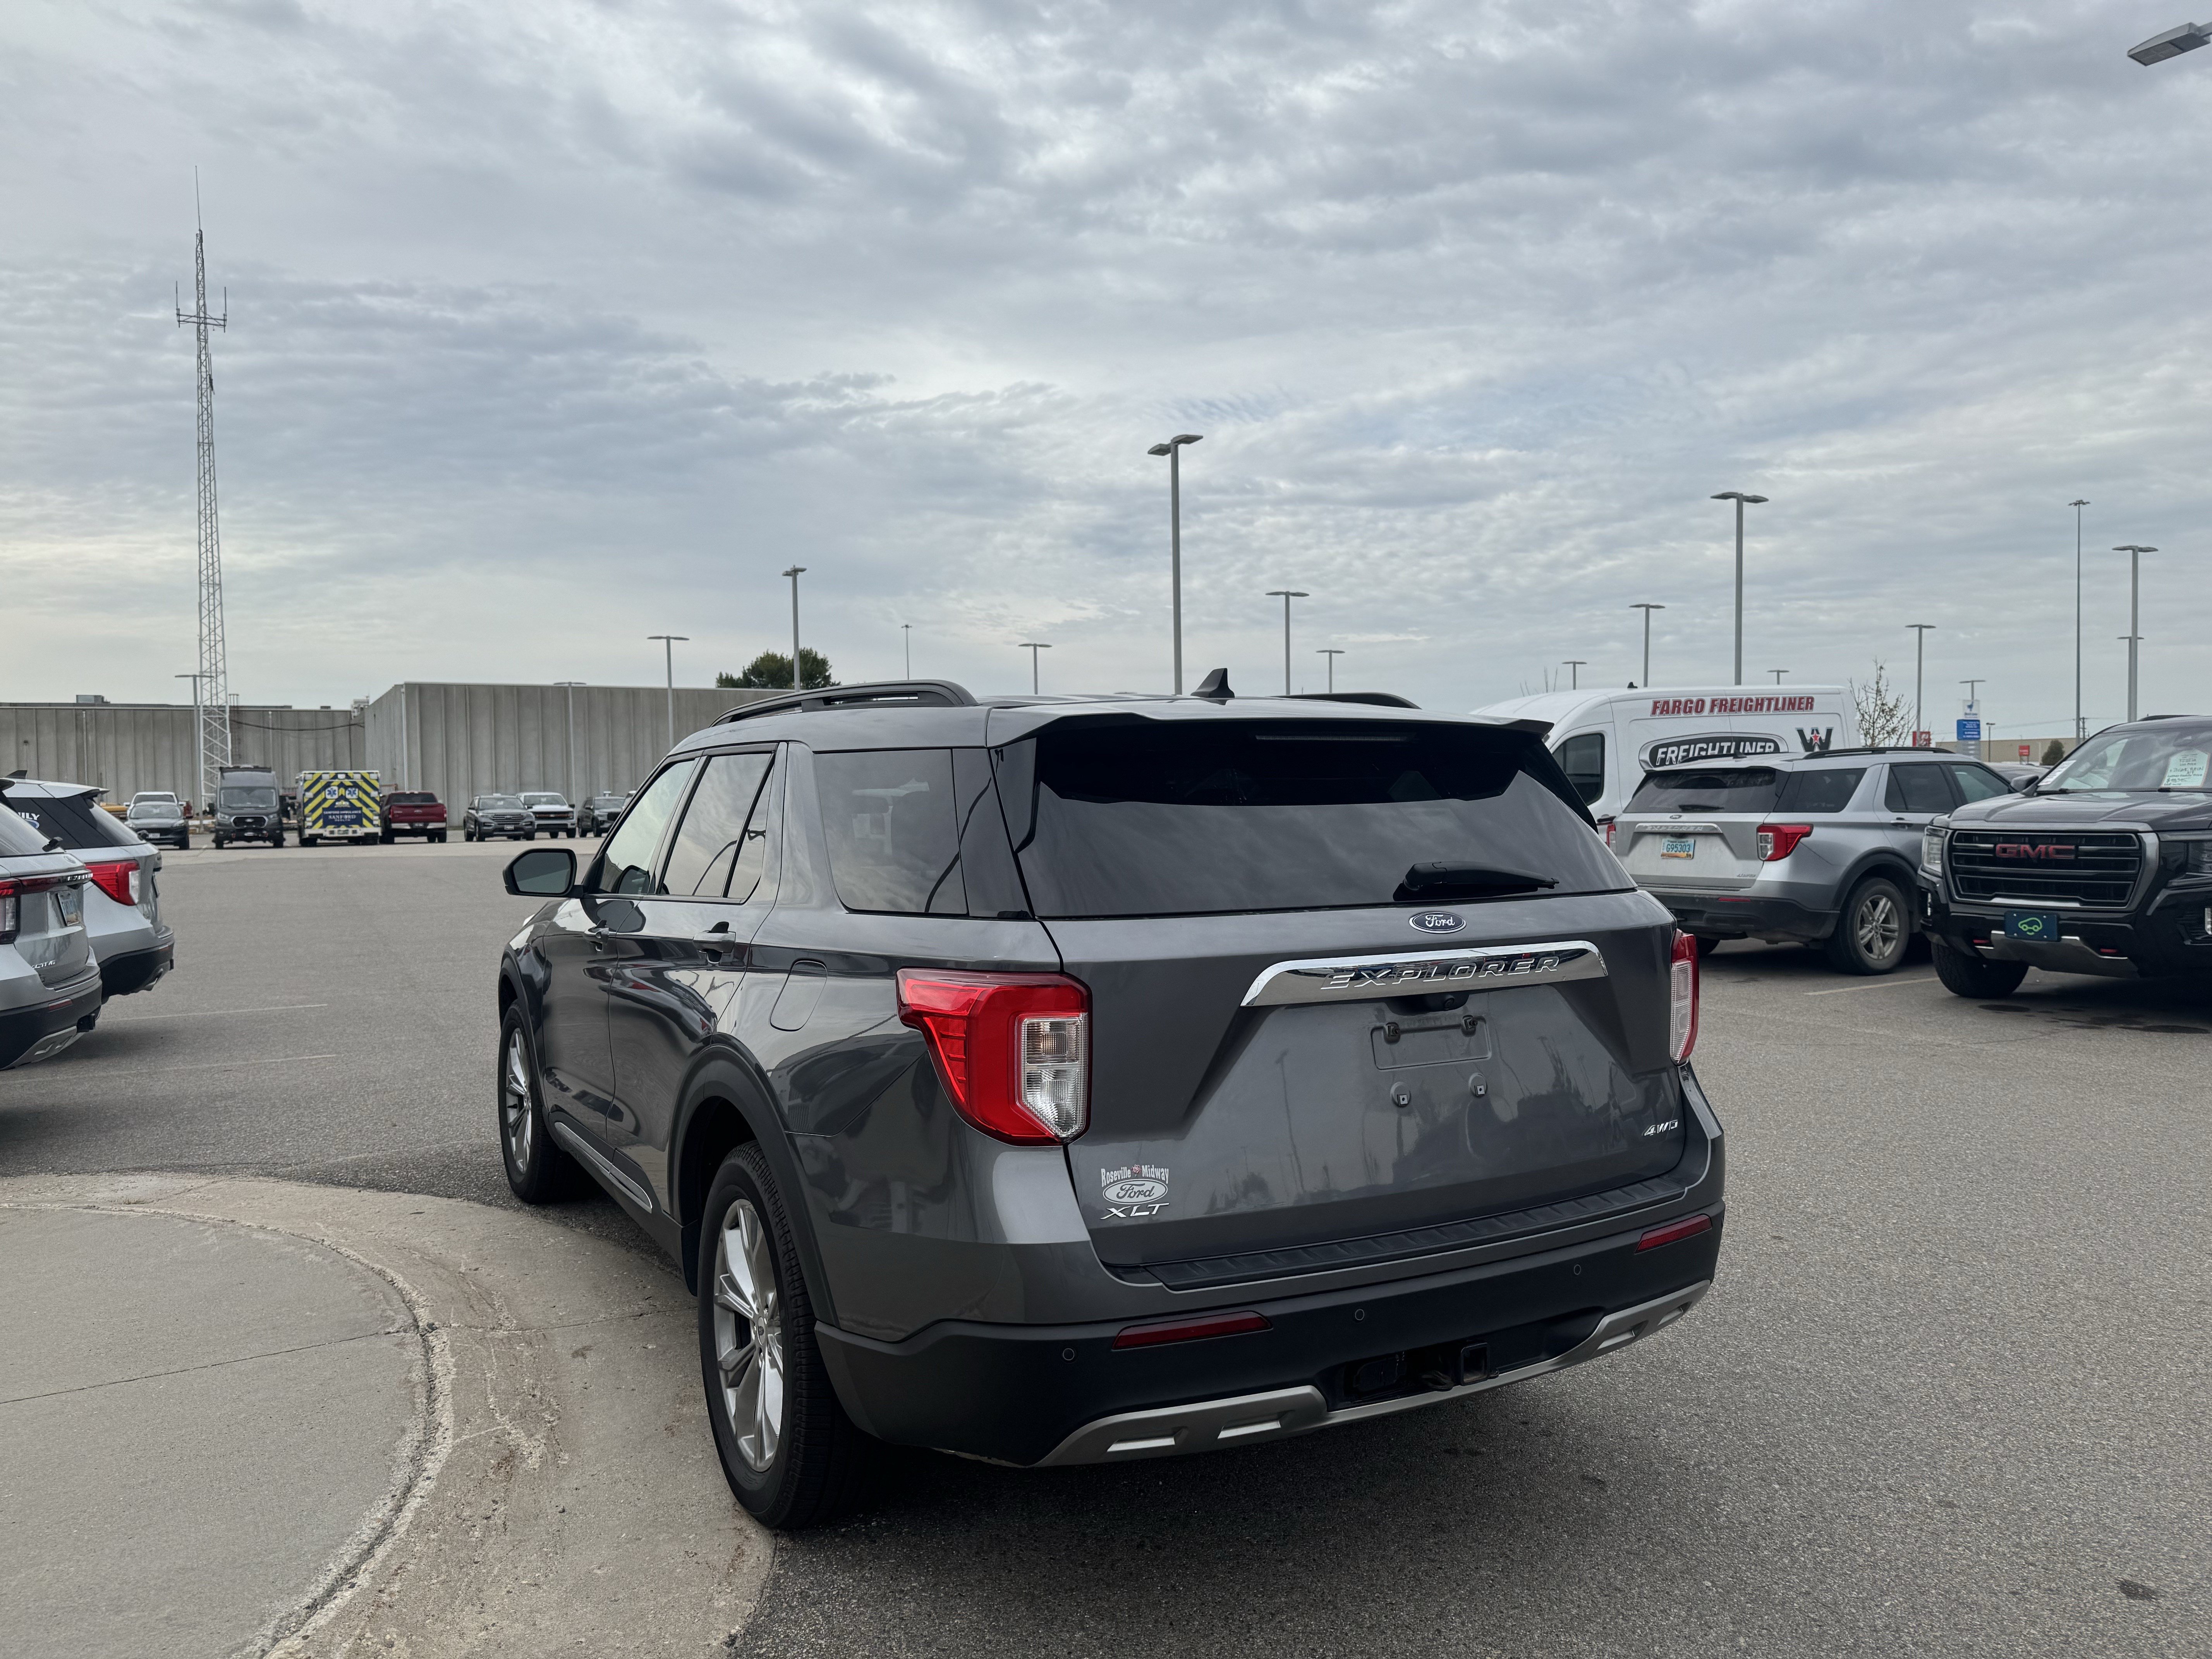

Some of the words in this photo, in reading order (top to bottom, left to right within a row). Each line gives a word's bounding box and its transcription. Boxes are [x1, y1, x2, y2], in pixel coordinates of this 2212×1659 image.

[1650, 698, 1705, 716] FARGO
[1709, 696, 1815, 714] FREIGHTLINER
[18, 812, 40, 820] ILY
[1666, 844, 1690, 853] G95303
[1996, 844, 2075, 859] GMC
[1425, 914, 1455, 927] Ford
[1321, 955, 1560, 990] EXPLORER
[1642, 1119, 1678, 1136] 4WD
[1101, 1166, 1131, 1187] Roseville
[1142, 1164, 1169, 1184] Midway
[1116, 1183, 1155, 1199] Ford
[1100, 1202, 1170, 1220] XLT
